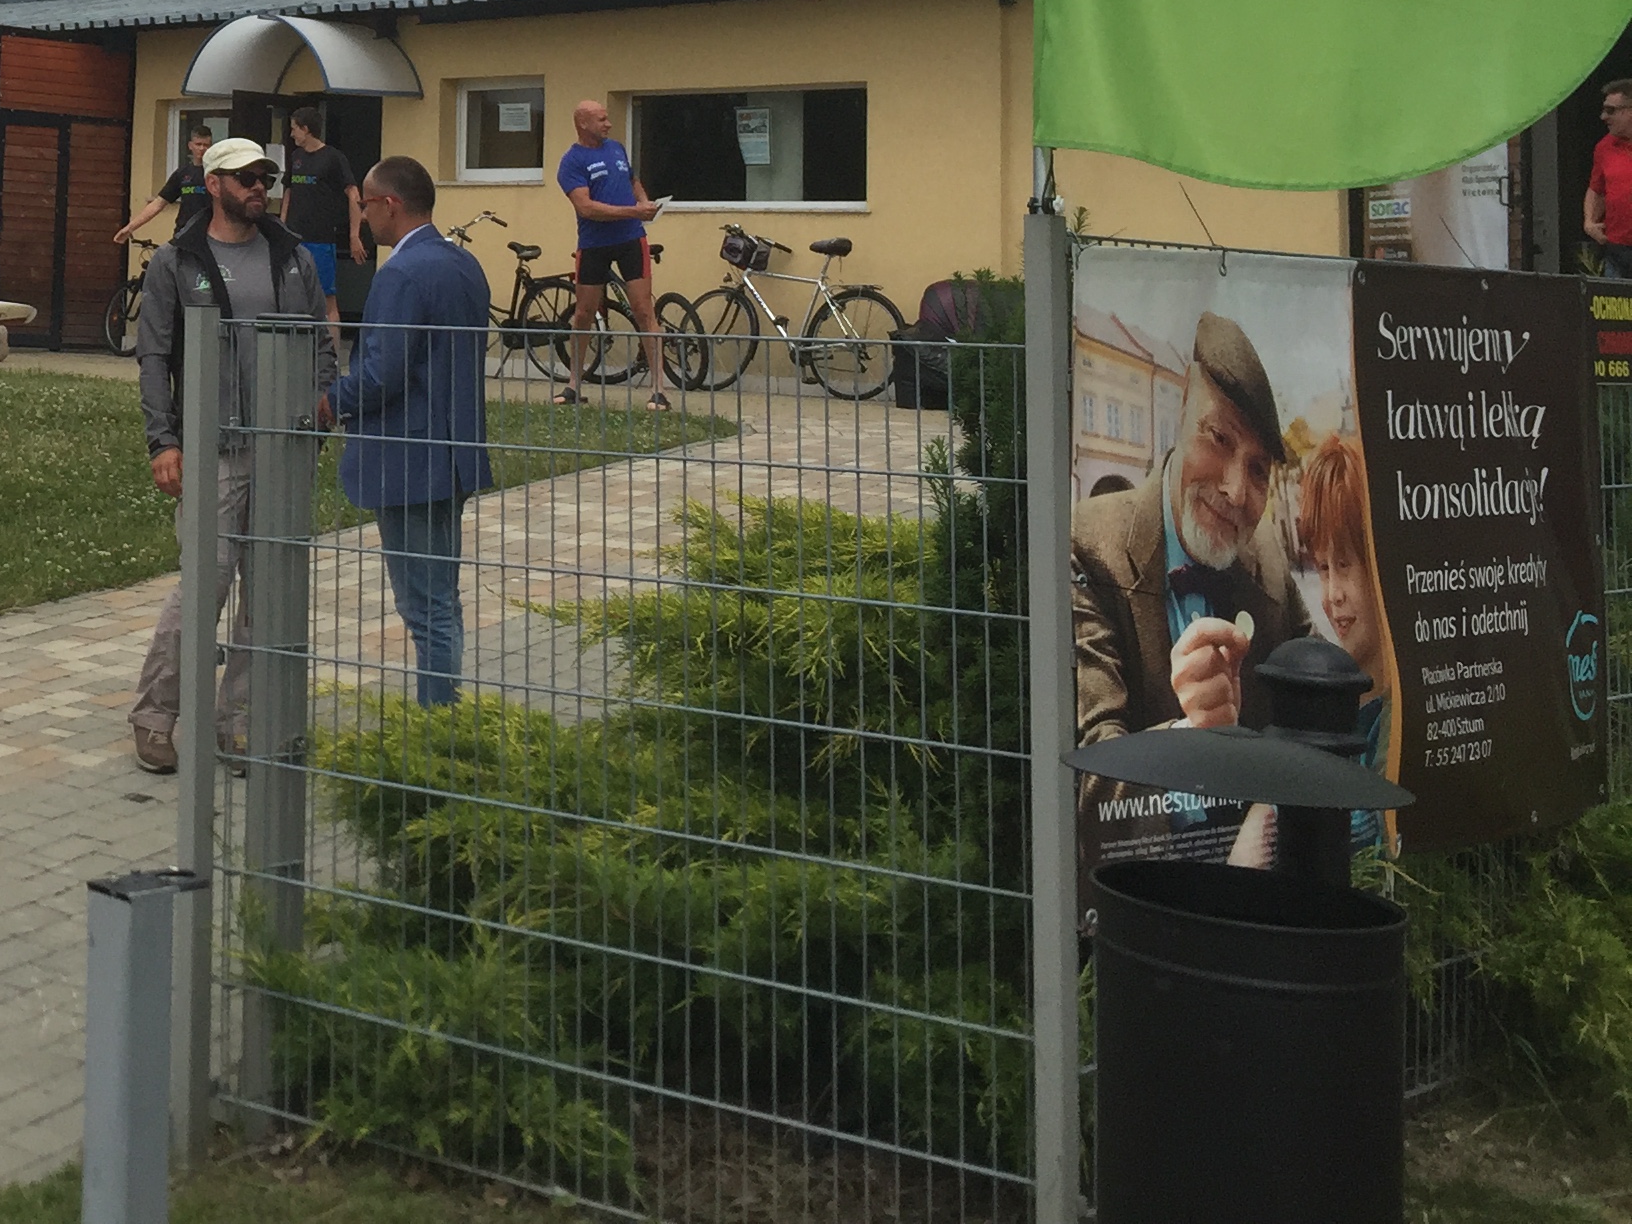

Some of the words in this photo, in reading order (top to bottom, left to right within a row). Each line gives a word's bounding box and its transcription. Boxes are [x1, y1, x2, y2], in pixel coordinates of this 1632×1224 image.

[1377, 311, 1530, 374] Serwujemy
[1386, 389, 1466, 451] łatwą
[1468, 390, 1477, 438] i
[1406, 560, 1466, 595] Przenieś
[1469, 557, 1505, 593] swoje
[1507, 552, 1547, 588] kredyty
[1415, 610, 1430, 643] do
[1433, 614, 1457, 640] nas
[1462, 606, 1467, 637] i
[1471, 599, 1529, 636] odetchnij
[1456, 657, 1504, 680] Partnerska
[1435, 688, 1487, 710] Mickiewicza
[1487, 682, 1506, 703] 2/10
[1456, 716, 1485, 735] Sztum
[1435, 747, 1449, 767] 55
[1450, 744, 1466, 764] 247
[1469, 743, 1480, 761] 23
[1481, 739, 1493, 758] 07
